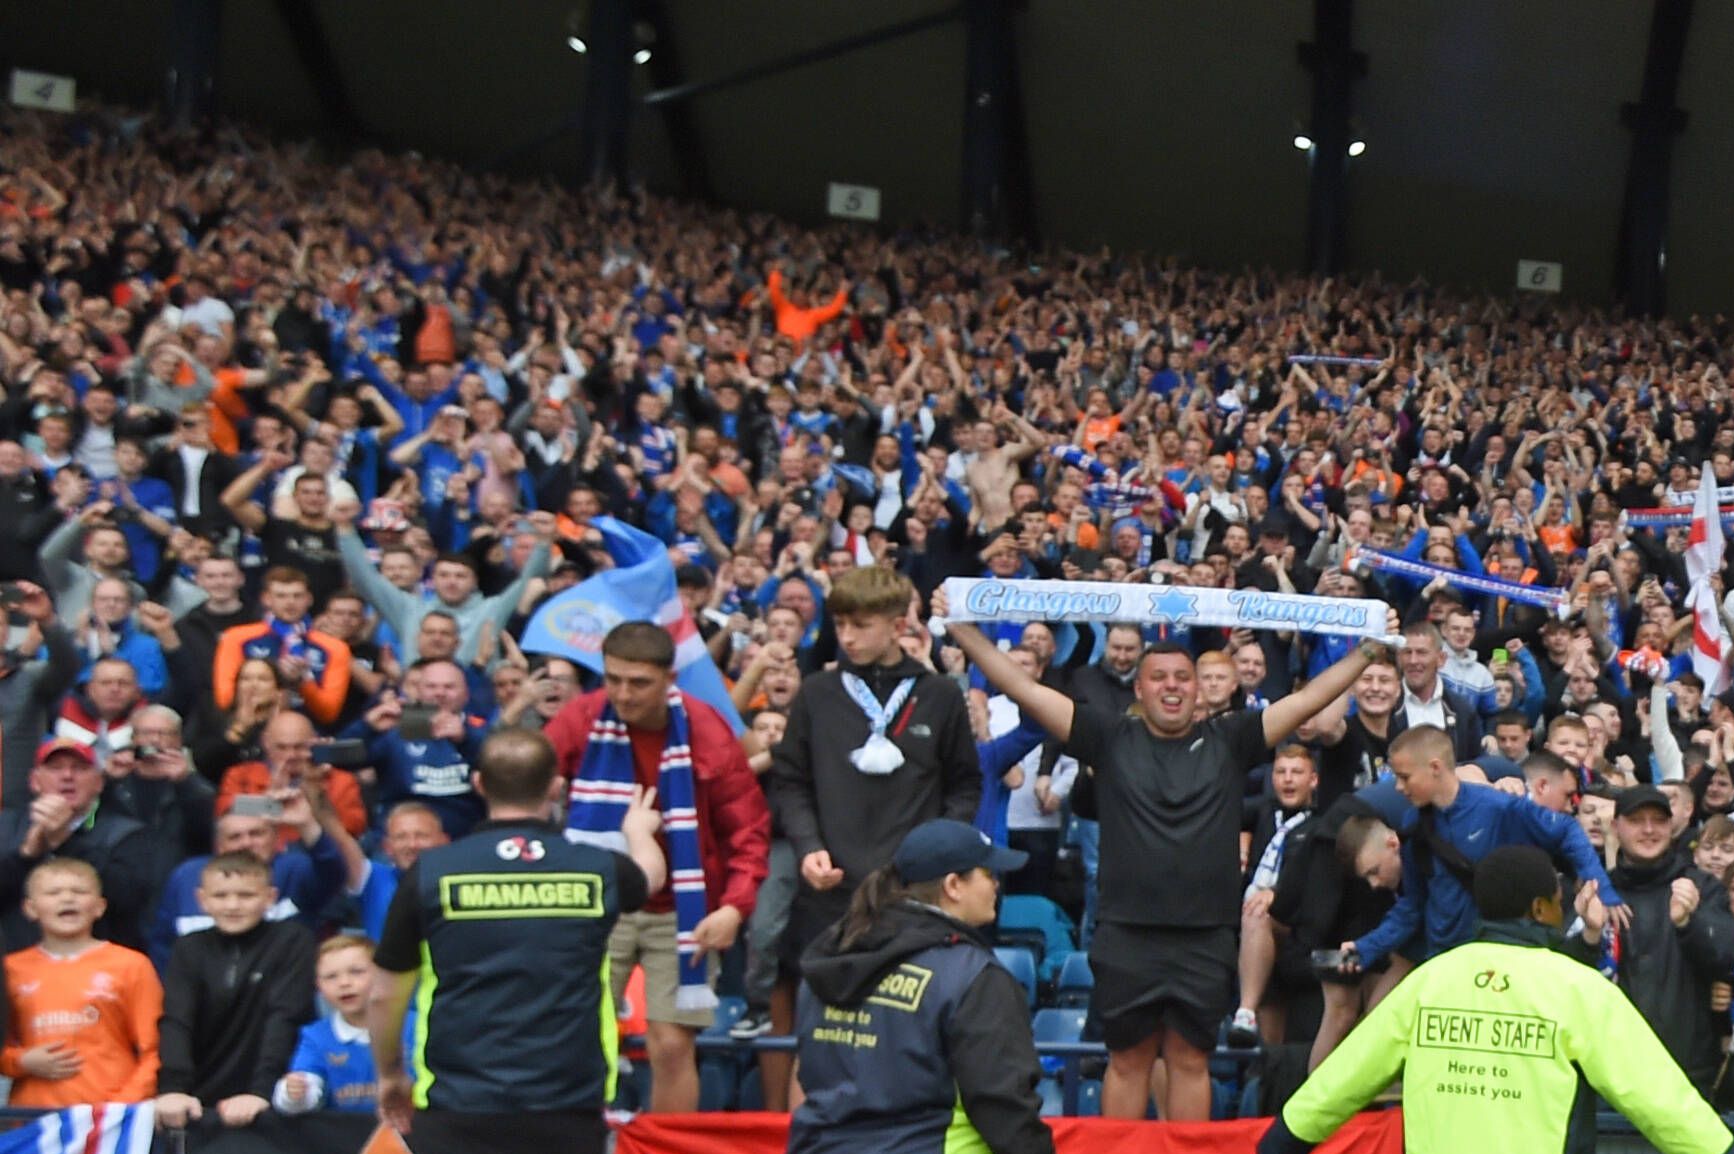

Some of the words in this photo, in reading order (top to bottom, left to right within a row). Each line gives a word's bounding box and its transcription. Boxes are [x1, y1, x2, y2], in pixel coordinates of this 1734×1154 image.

[34, 80, 54, 101] 4
[846, 190, 863, 212] 5
[1532, 265, 1549, 285] 6
[965, 581, 1122, 617] Glasgow
[1227, 590, 1368, 630] Rangers
[458, 882, 591, 908] MANAGER
[1426, 1013, 1484, 1045] EVENT
[1491, 1018, 1547, 1050] STAFF
[1448, 1060, 1486, 1076] Here
[1492, 1065, 1508, 1078] to
[1437, 1081, 1486, 1096] assist
[1491, 1087, 1522, 1100] you
